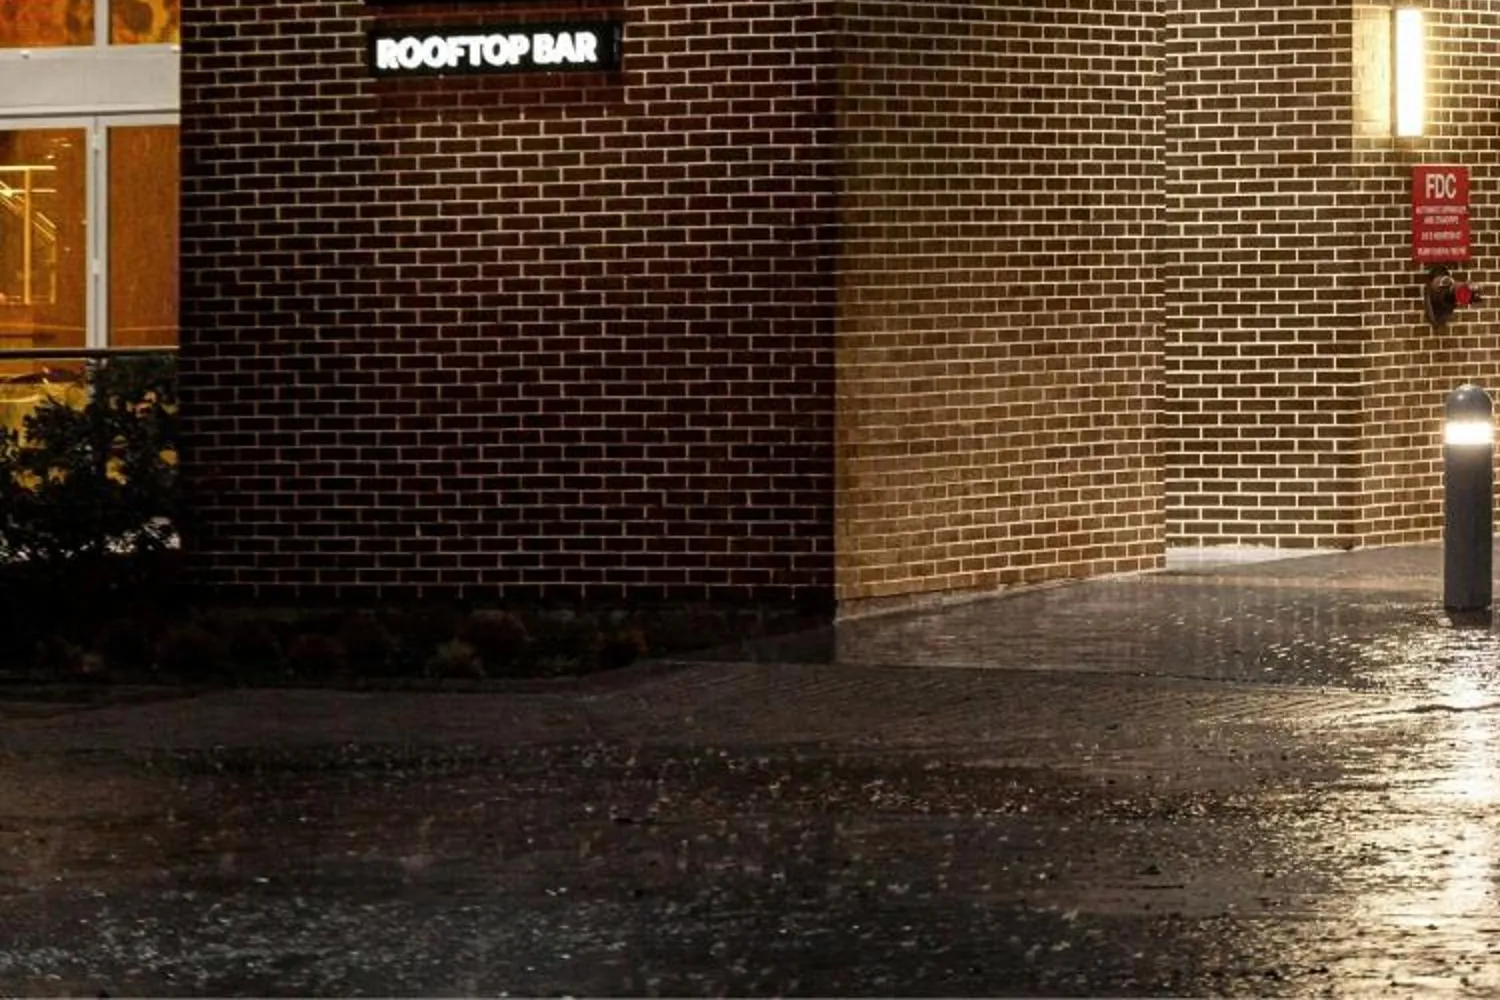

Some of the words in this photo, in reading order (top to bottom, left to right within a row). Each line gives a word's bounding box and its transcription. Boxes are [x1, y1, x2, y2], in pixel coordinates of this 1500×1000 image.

[376, 34, 530, 69] ROOFTOP
[532, 31, 597, 64] BAR
[1425, 173, 1457, 199] FDC
